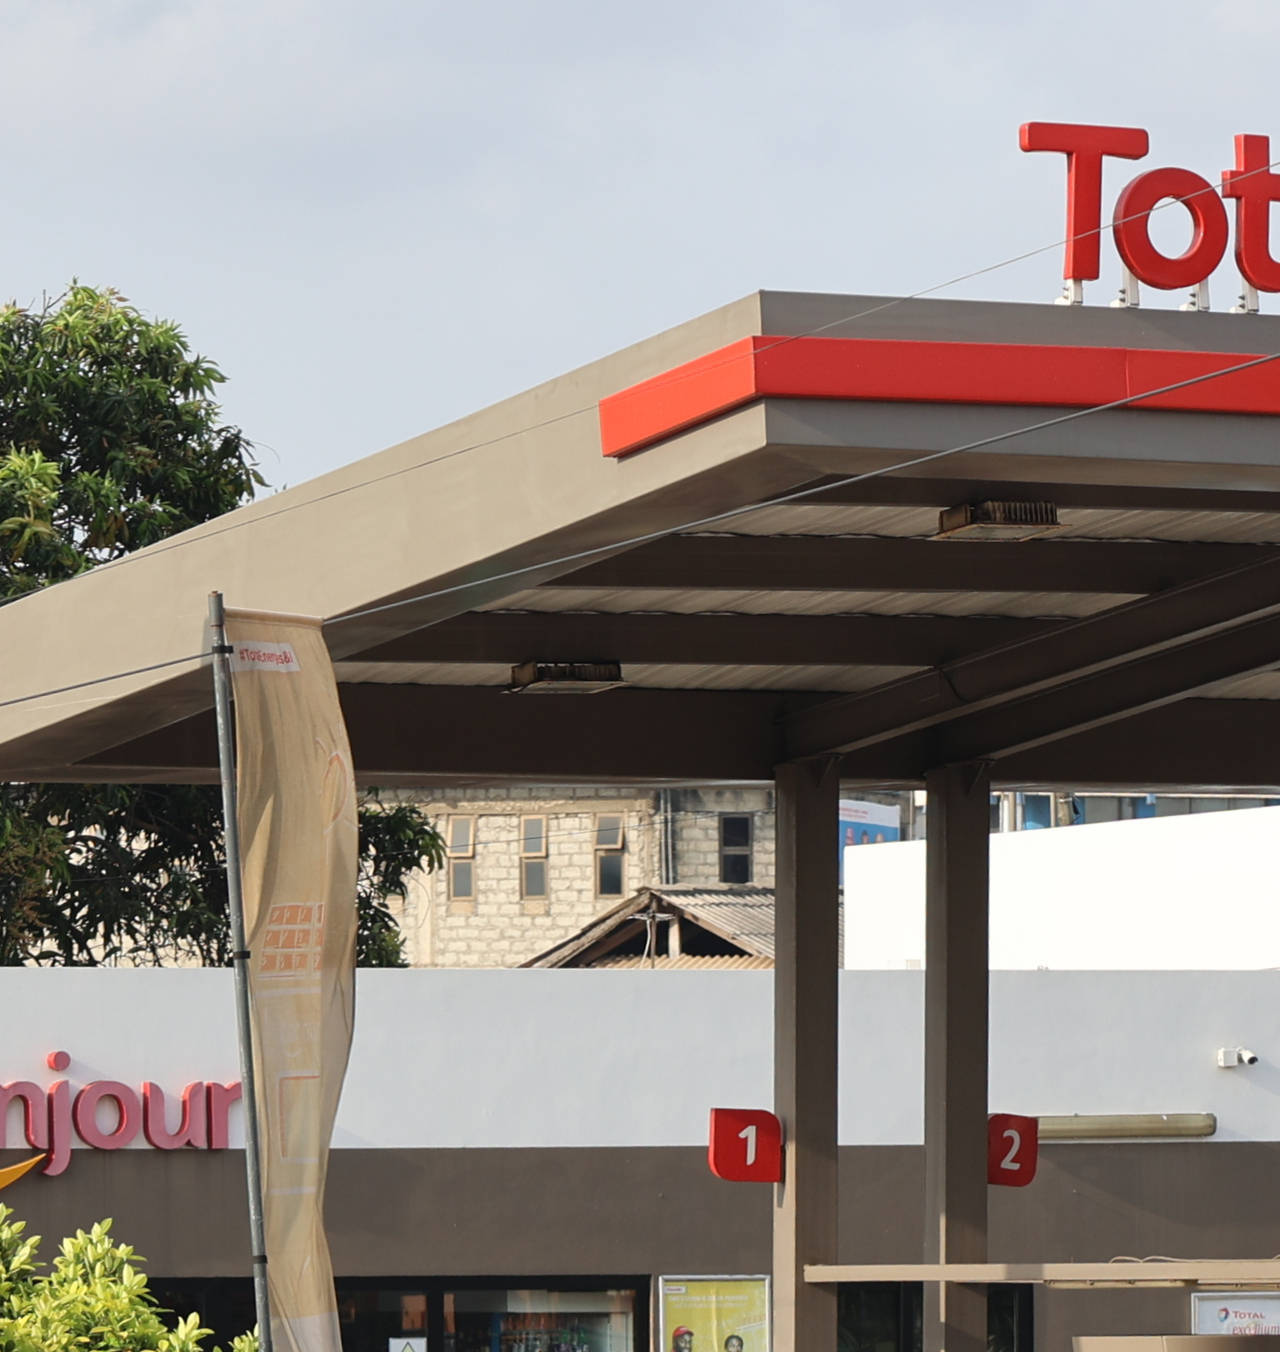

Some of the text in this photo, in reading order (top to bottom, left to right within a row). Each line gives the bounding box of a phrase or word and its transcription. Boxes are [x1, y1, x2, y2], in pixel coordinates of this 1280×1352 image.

[738, 1125, 756, 1165] 1
[1000, 1129, 1021, 1170] 2
[1233, 1311, 1265, 1319] TOTAL
